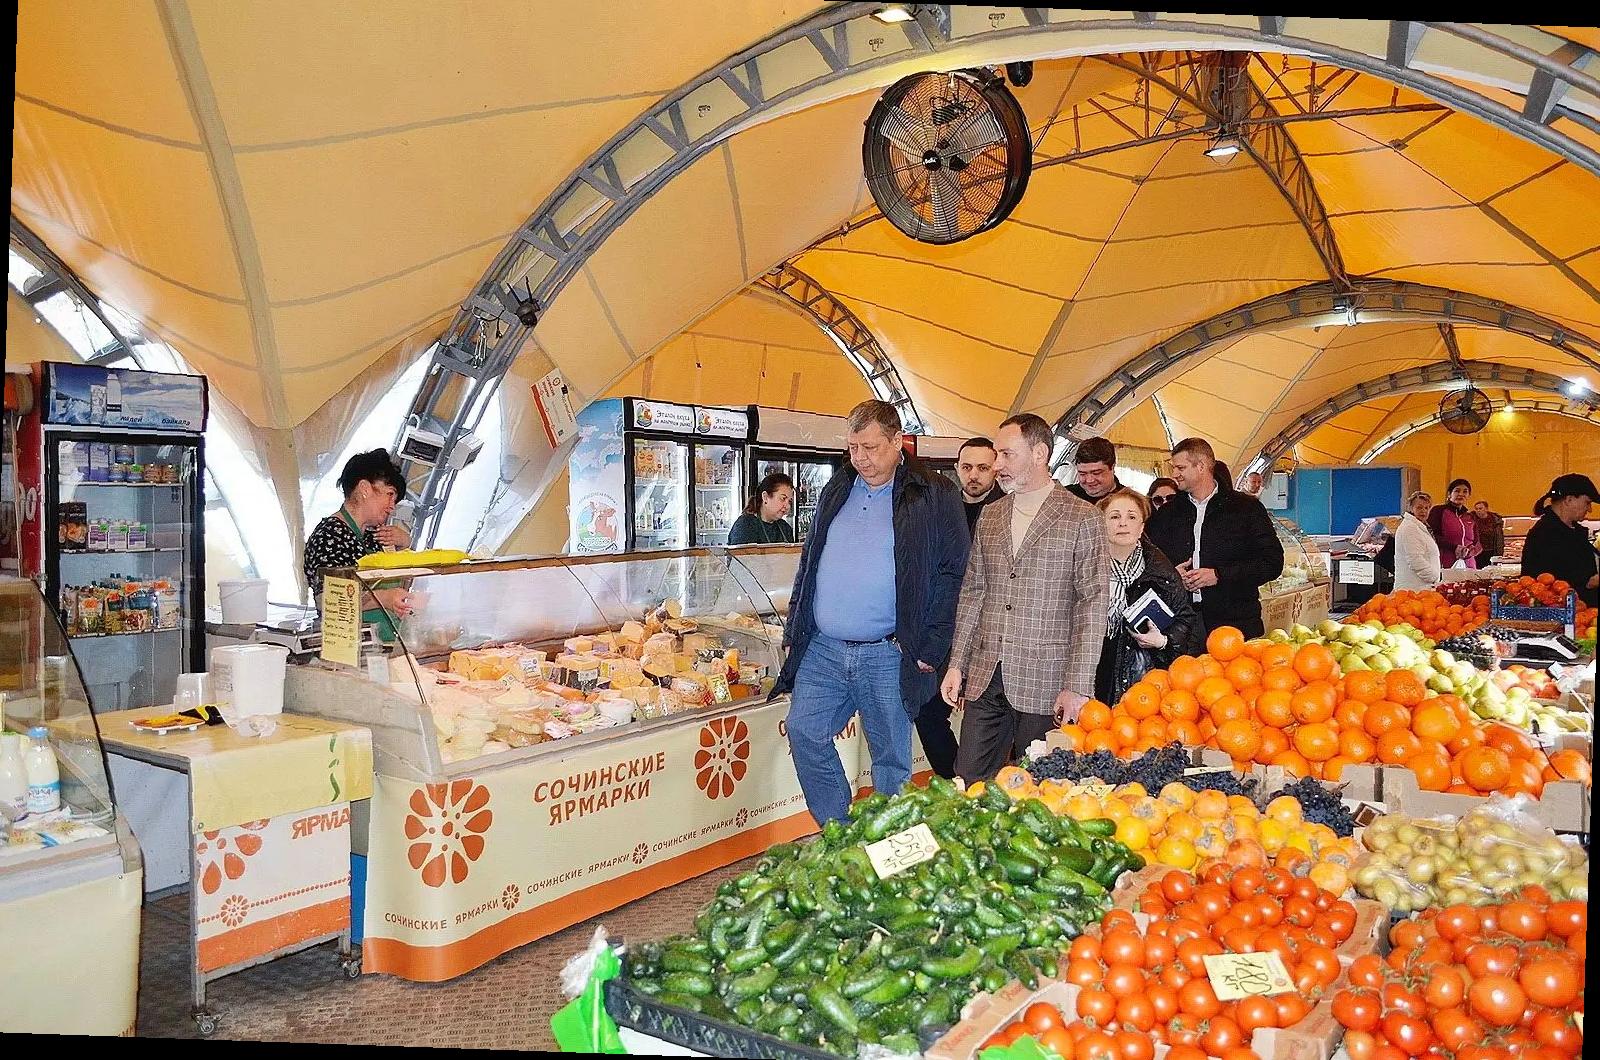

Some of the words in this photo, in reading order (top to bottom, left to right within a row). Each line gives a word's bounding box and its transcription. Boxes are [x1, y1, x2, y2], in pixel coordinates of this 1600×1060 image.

[533, 751, 665, 803] СОЧИНСКИЕ
[548, 778, 652, 826] ЯРМАРКИ
[750, 797, 788, 818] СОЧИНСКИЕ
[652, 830, 698, 852] СОЧИНСКИЕ
[700, 817, 734, 836] ЯРМАРКИ
[526, 868, 583, 895] СОЧИНСКИЕ
[587, 853, 630, 874] ЯРМАРКИ
[384, 912, 448, 930] СОЧИНСКИЕ
[455, 898, 499, 925] ЯРМАРКИ
